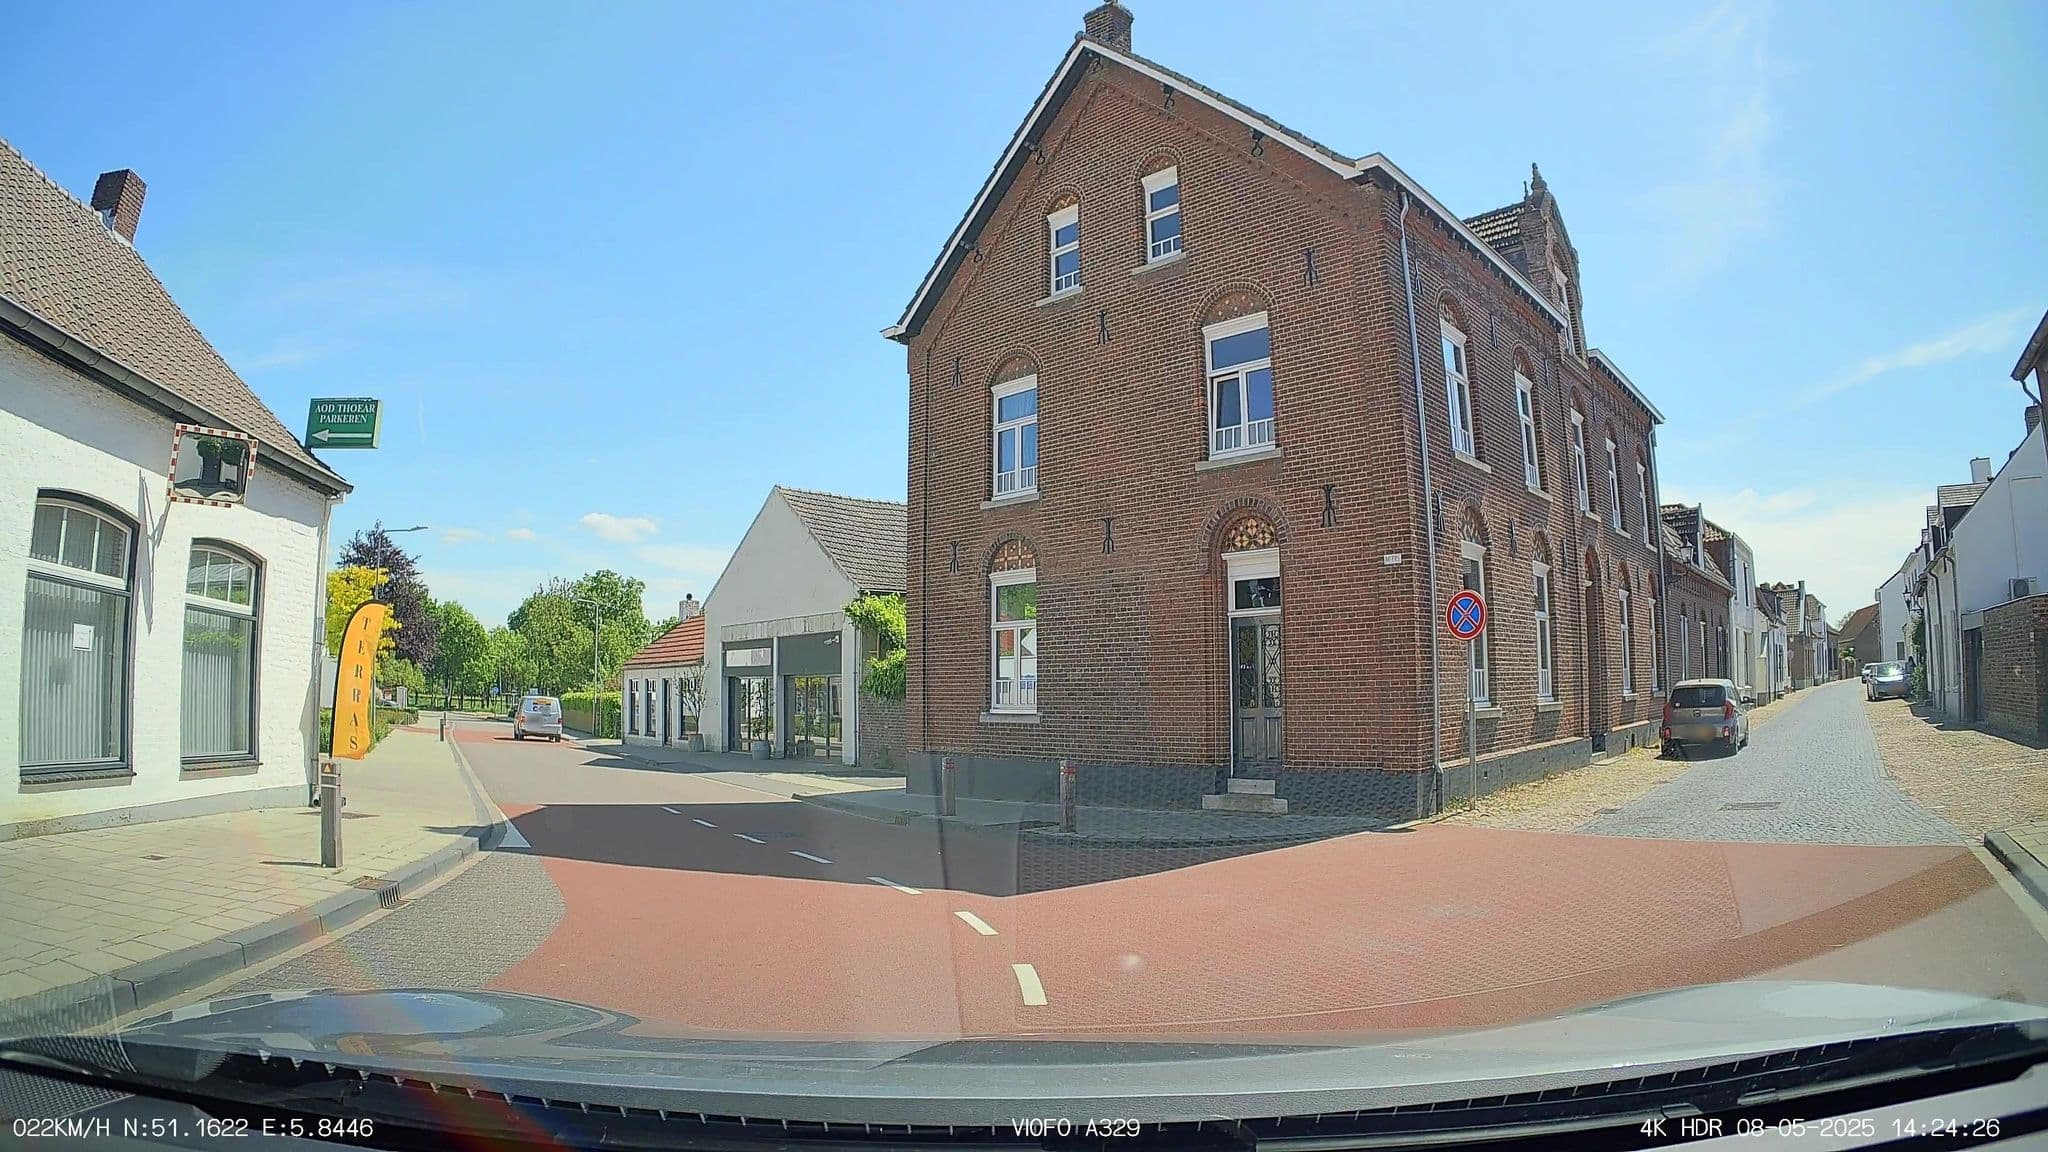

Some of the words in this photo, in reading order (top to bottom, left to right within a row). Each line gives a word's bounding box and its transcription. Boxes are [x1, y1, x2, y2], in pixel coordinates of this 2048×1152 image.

[315, 403, 335, 413] AOD
[337, 403, 376, 413] THOEAR
[319, 413, 368, 424] PARKEREN
[349, 615, 372, 751] TERRAS
